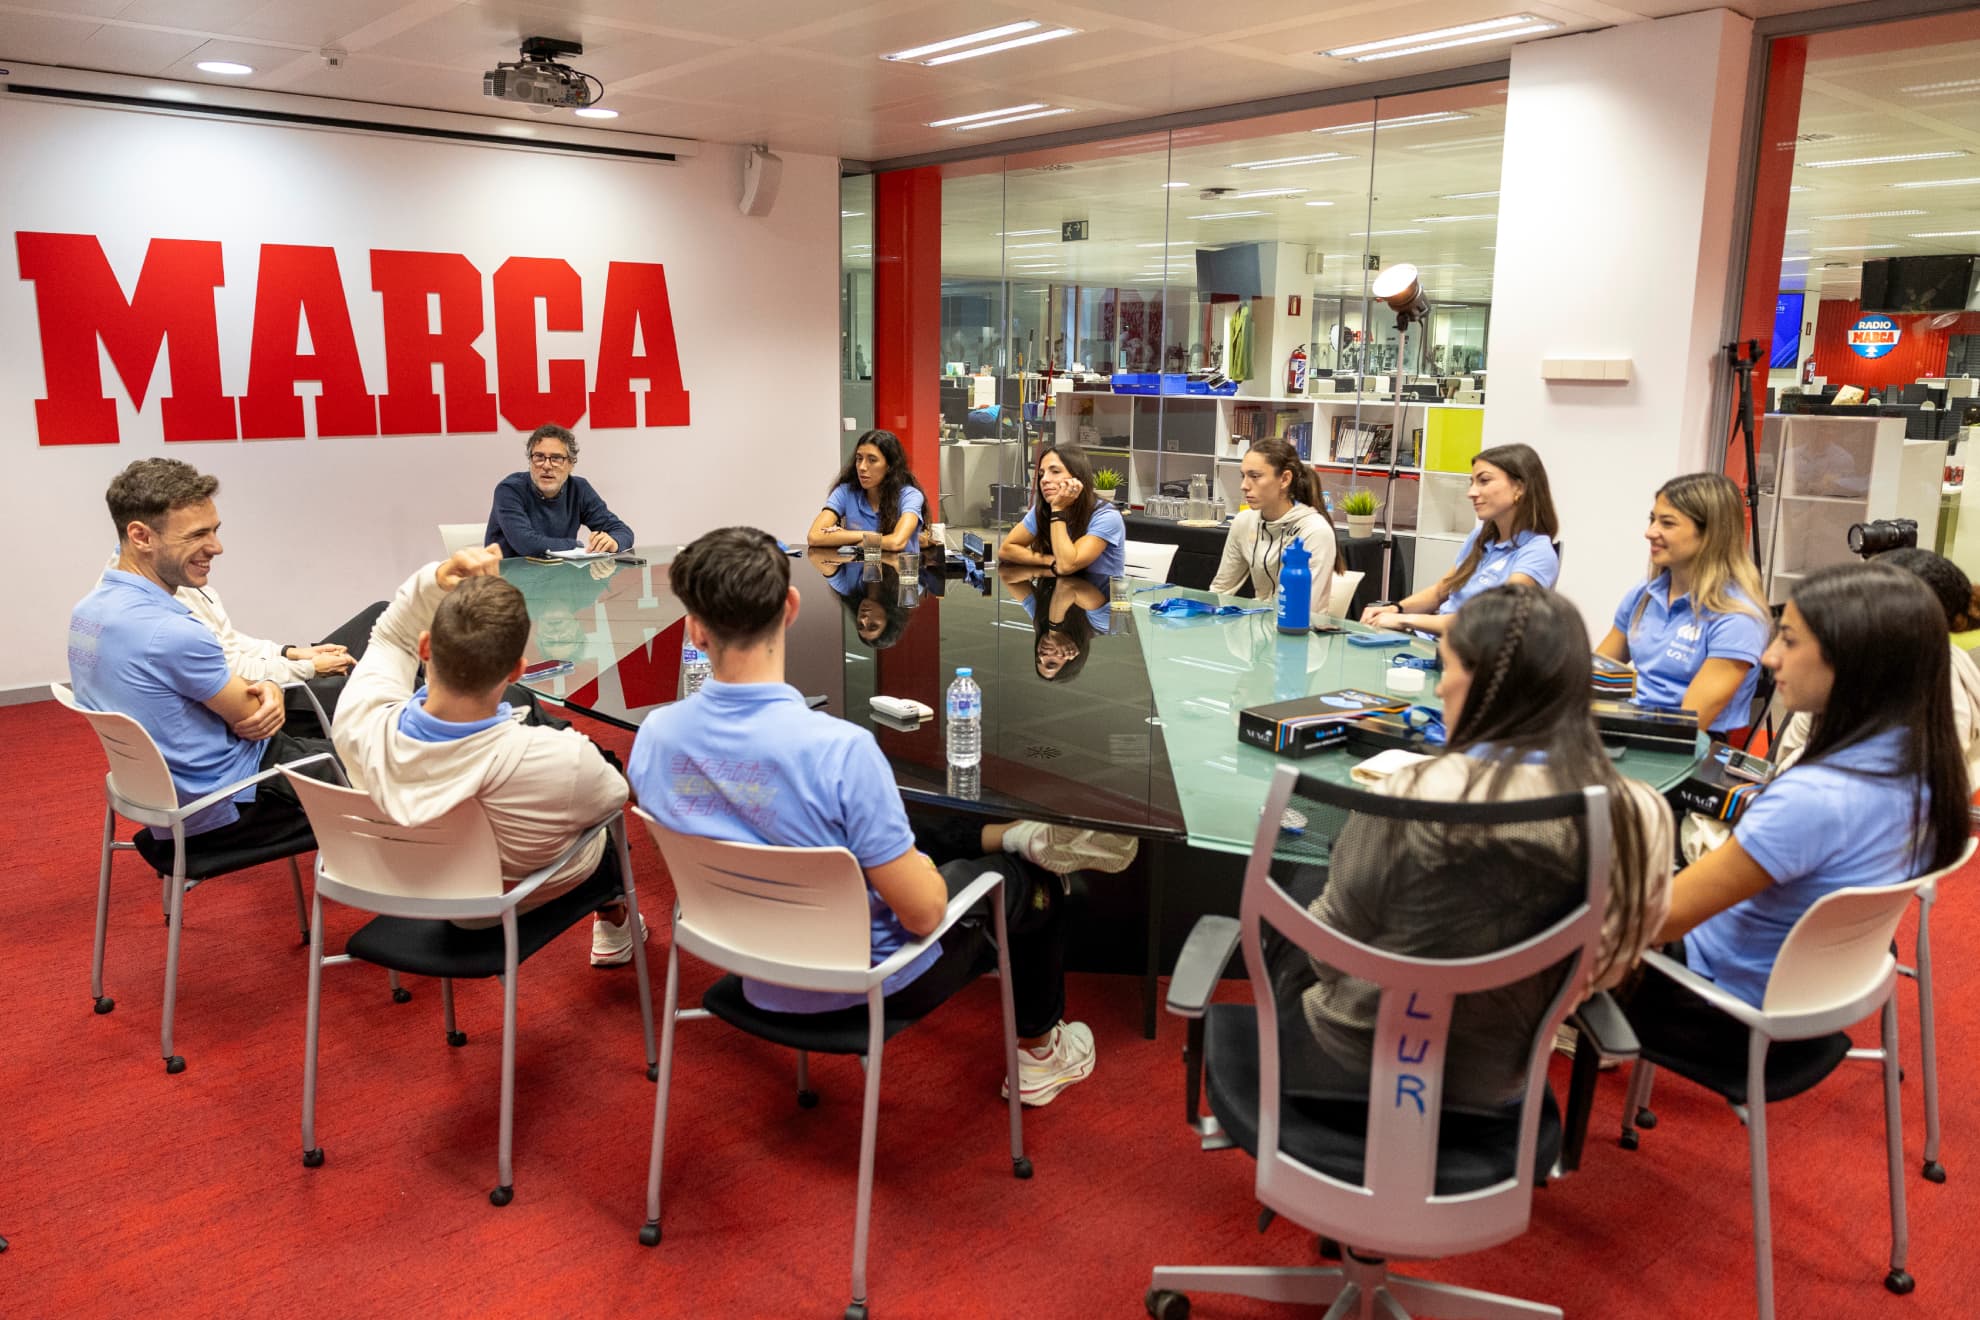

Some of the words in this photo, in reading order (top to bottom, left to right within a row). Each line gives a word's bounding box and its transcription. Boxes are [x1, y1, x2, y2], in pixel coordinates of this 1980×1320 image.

[15, 231, 691, 447] MARCA
[1852, 331, 1895, 344] MARCA
[1858, 321, 1892, 330] RADIO
[1395, 991, 1433, 1116] LUR
